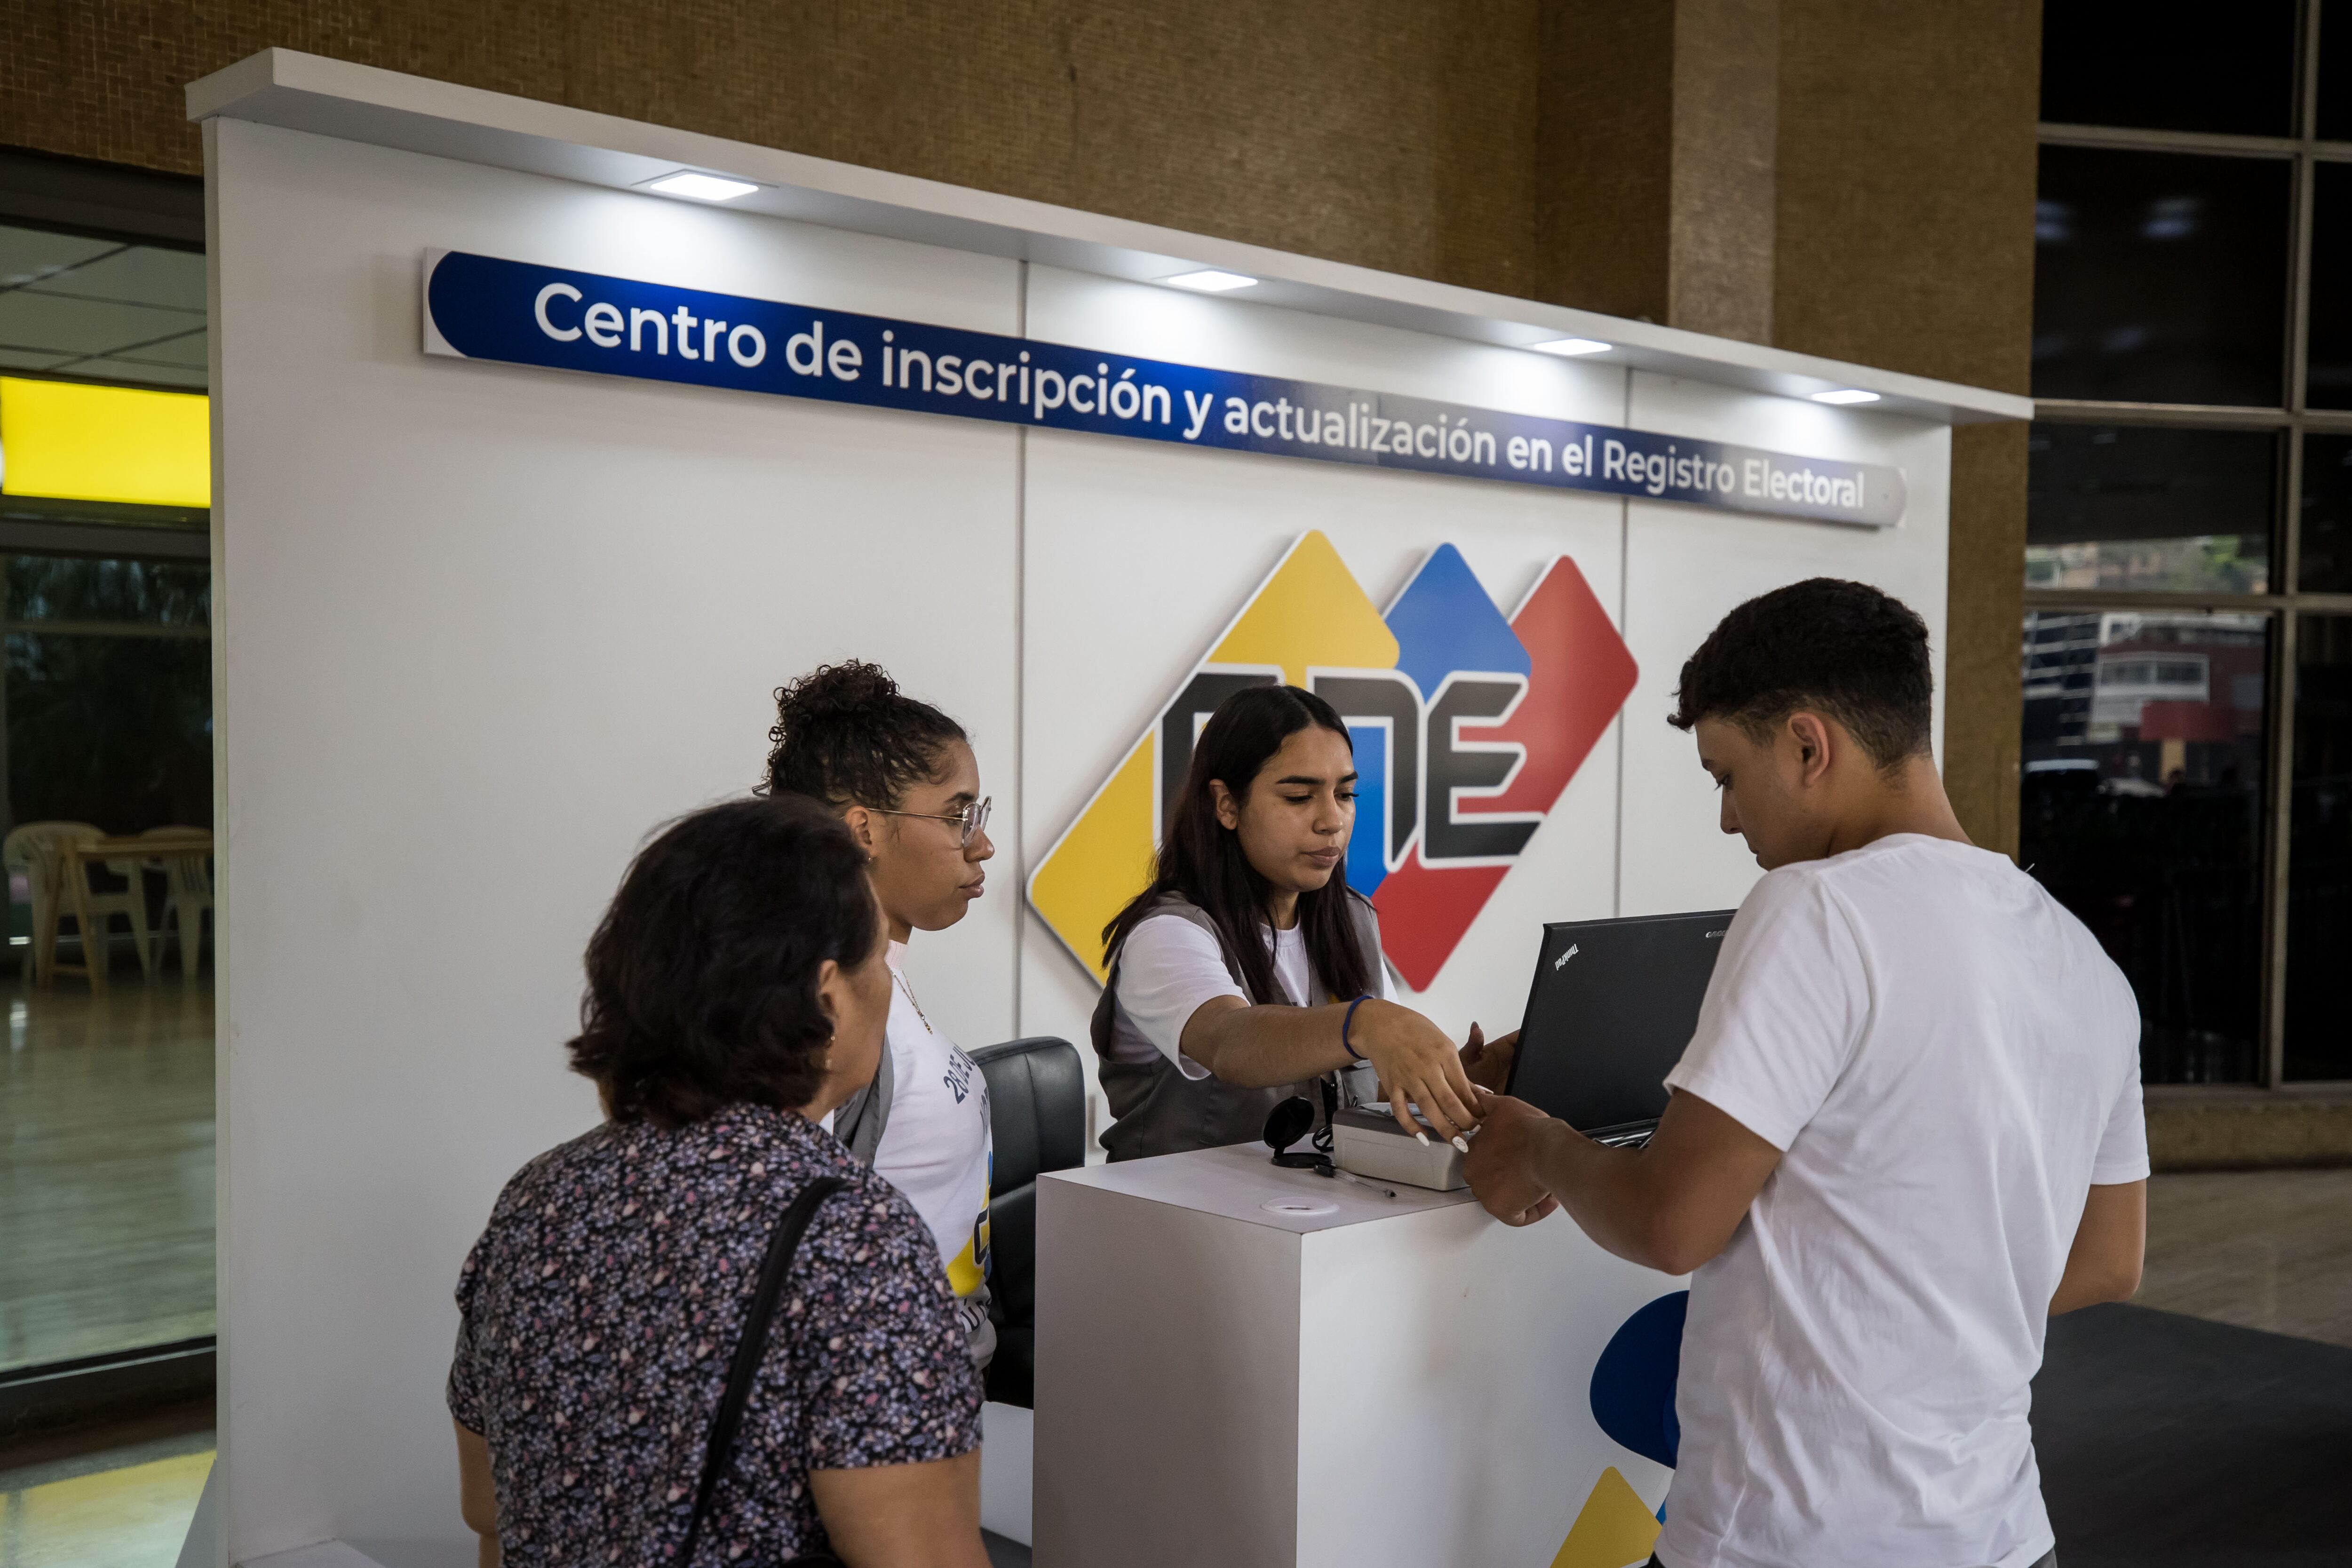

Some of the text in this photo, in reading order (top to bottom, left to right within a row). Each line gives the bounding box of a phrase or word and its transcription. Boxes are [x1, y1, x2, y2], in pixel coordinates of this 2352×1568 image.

[534, 282, 1865, 509] Centro de inscripción y actualización en el Registro Electoral
[1555, 943, 1579, 971] ThinkPad
[944, 1069, 969, 1104] 28
